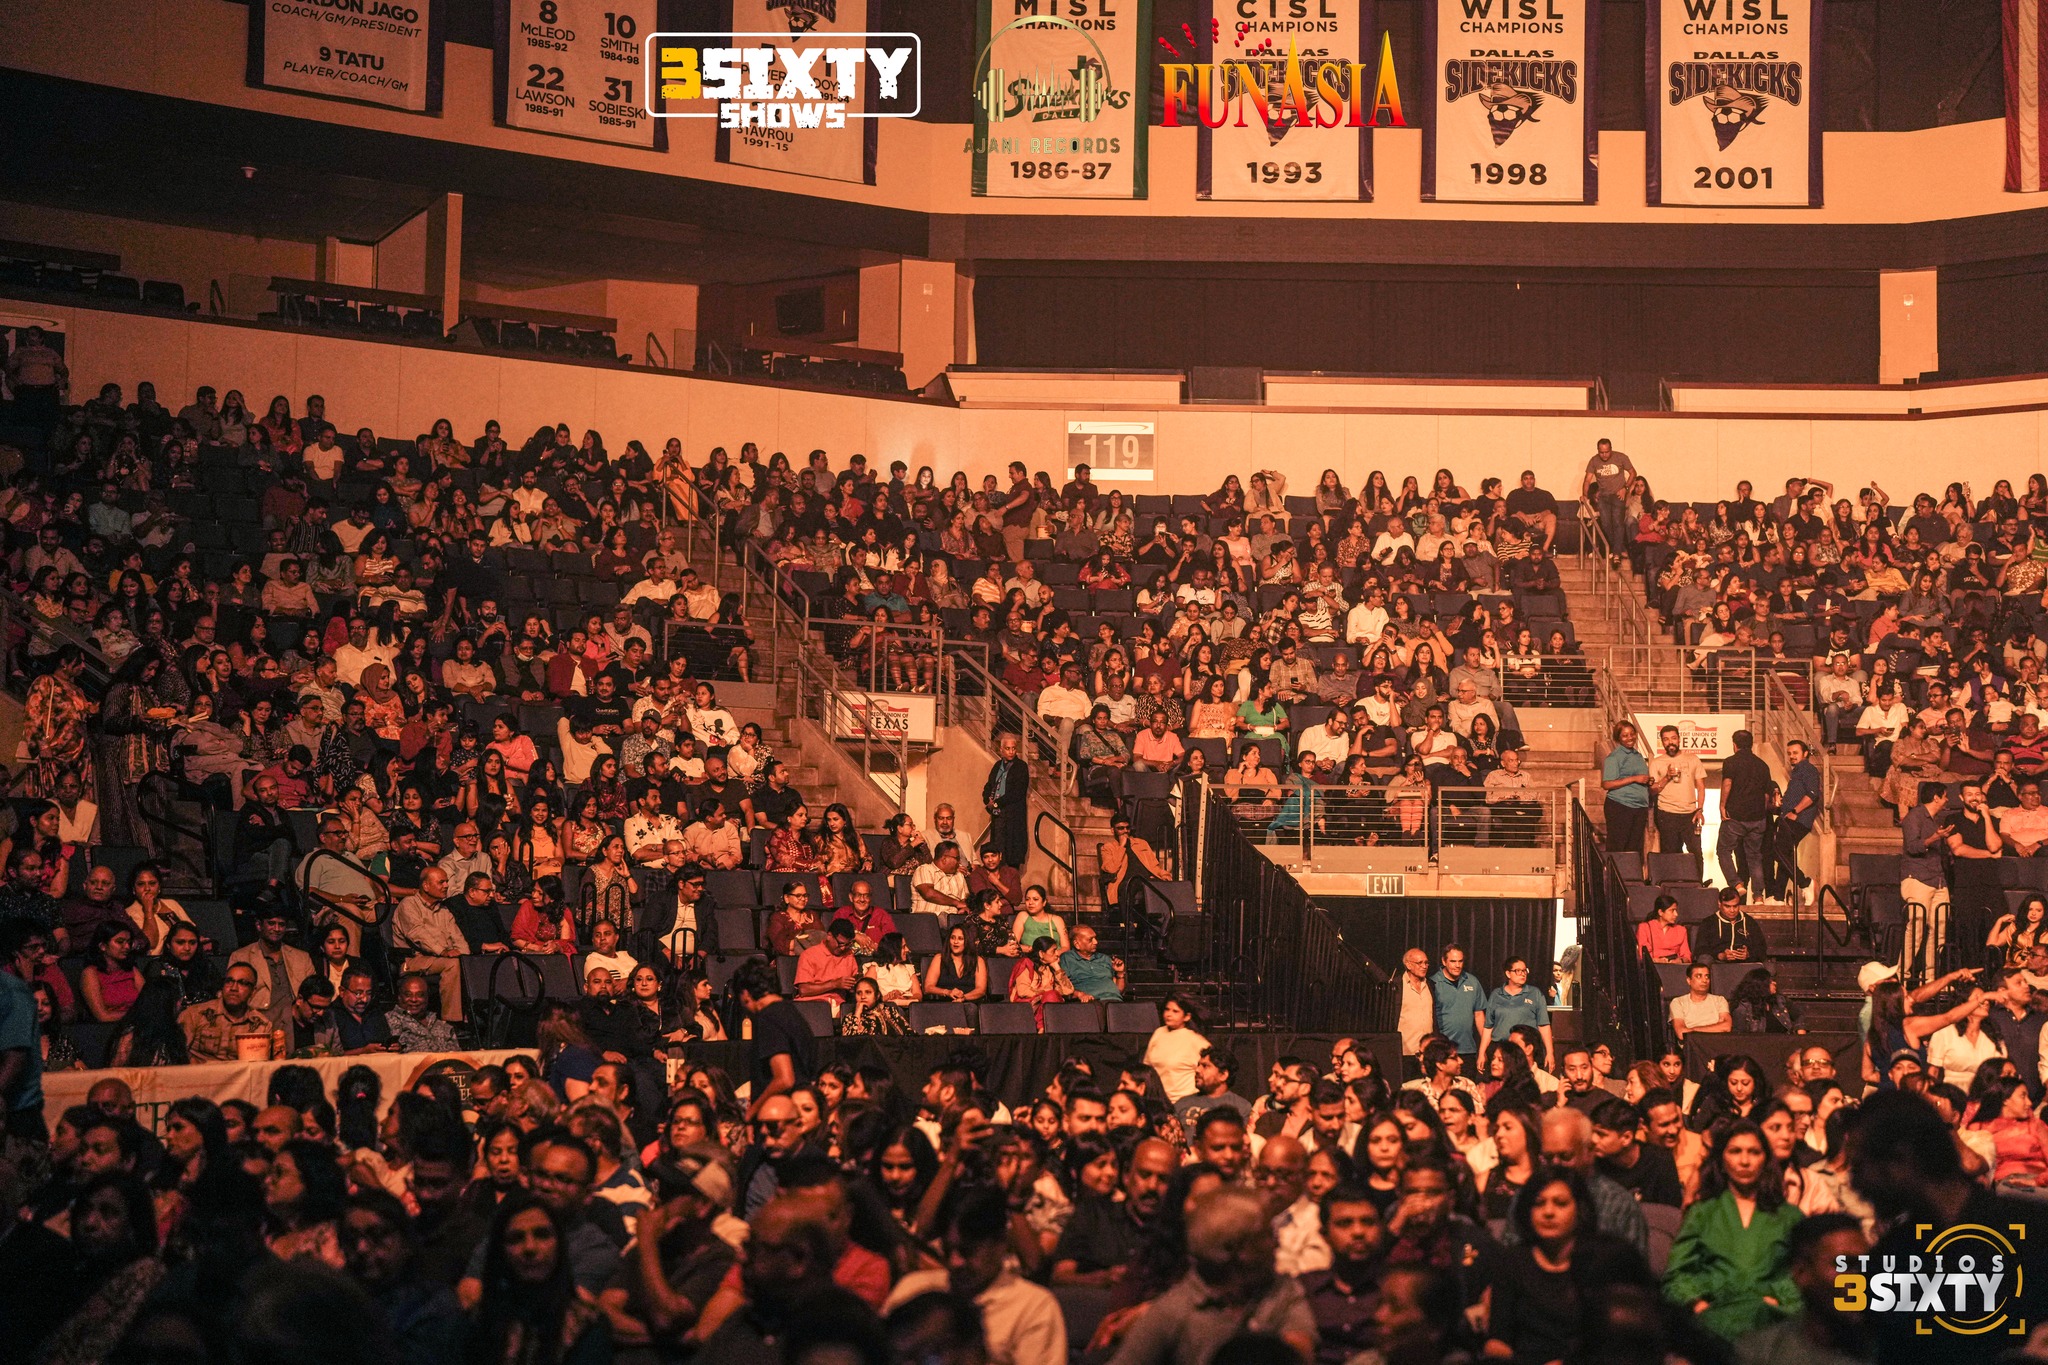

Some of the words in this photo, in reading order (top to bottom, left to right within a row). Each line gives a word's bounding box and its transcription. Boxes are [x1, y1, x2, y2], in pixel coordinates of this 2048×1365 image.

[297, 0, 364, 14] DON
[367, 5, 419, 24] JAGO
[539, 0, 558, 24] 8
[1014, 0, 1116, 16] MISL
[1237, 0, 1337, 18] CISL
[1460, 0, 1564, 20] WISL
[1683, 0, 1788, 21] WISL
[272, 2, 422, 38] COACH/GM/PRESIDENT
[604, 12, 637, 39] 10
[1014, 19, 1116, 31] HAMIONS
[1235, 21, 1338, 33] CHAMPIONS
[1460, 22, 1564, 34] CHAMPIONS
[1683, 23, 1789, 35] CHAMPIONS
[520, 22, 576, 42] McLEOD
[527, 37, 568, 52] 1985-92
[600, 37, 639, 54] SMITH
[1245, 48, 1329, 57] DALAS
[1470, 49, 1555, 58] DALLAS
[319, 46, 331, 61] 9
[335, 49, 384, 71] TATU
[600, 50, 640, 65] 1984-98
[1693, 51, 1779, 59] DALLAS
[283, 61, 409, 92] PLAYER/COACH/GM
[526, 64, 565, 91] 22
[1445, 58, 1577, 104] SIDEKICKS
[1668, 61, 1803, 106] SIDEKICKS
[516, 87, 575, 108] LAWSON
[603, 76, 633, 103] 31
[525, 103, 564, 117] 1985-91
[588, 100, 647, 120] SOBIESKI
[1042, 110, 1081, 120] DALL
[598, 115, 637, 129] 1985-91
[743, 137, 789, 152] 1991-15
[1011, 161, 1112, 180] 1986-87
[1246, 161, 1322, 184] 1993
[1470, 162, 1547, 185] 1998
[1693, 166, 1773, 189] 2001
[1084, 434, 1139, 468] 119
[871, 717, 909, 730] EXAS
[1682, 737, 1717, 748] EXAS
[1373, 876, 1399, 894] EXIT
